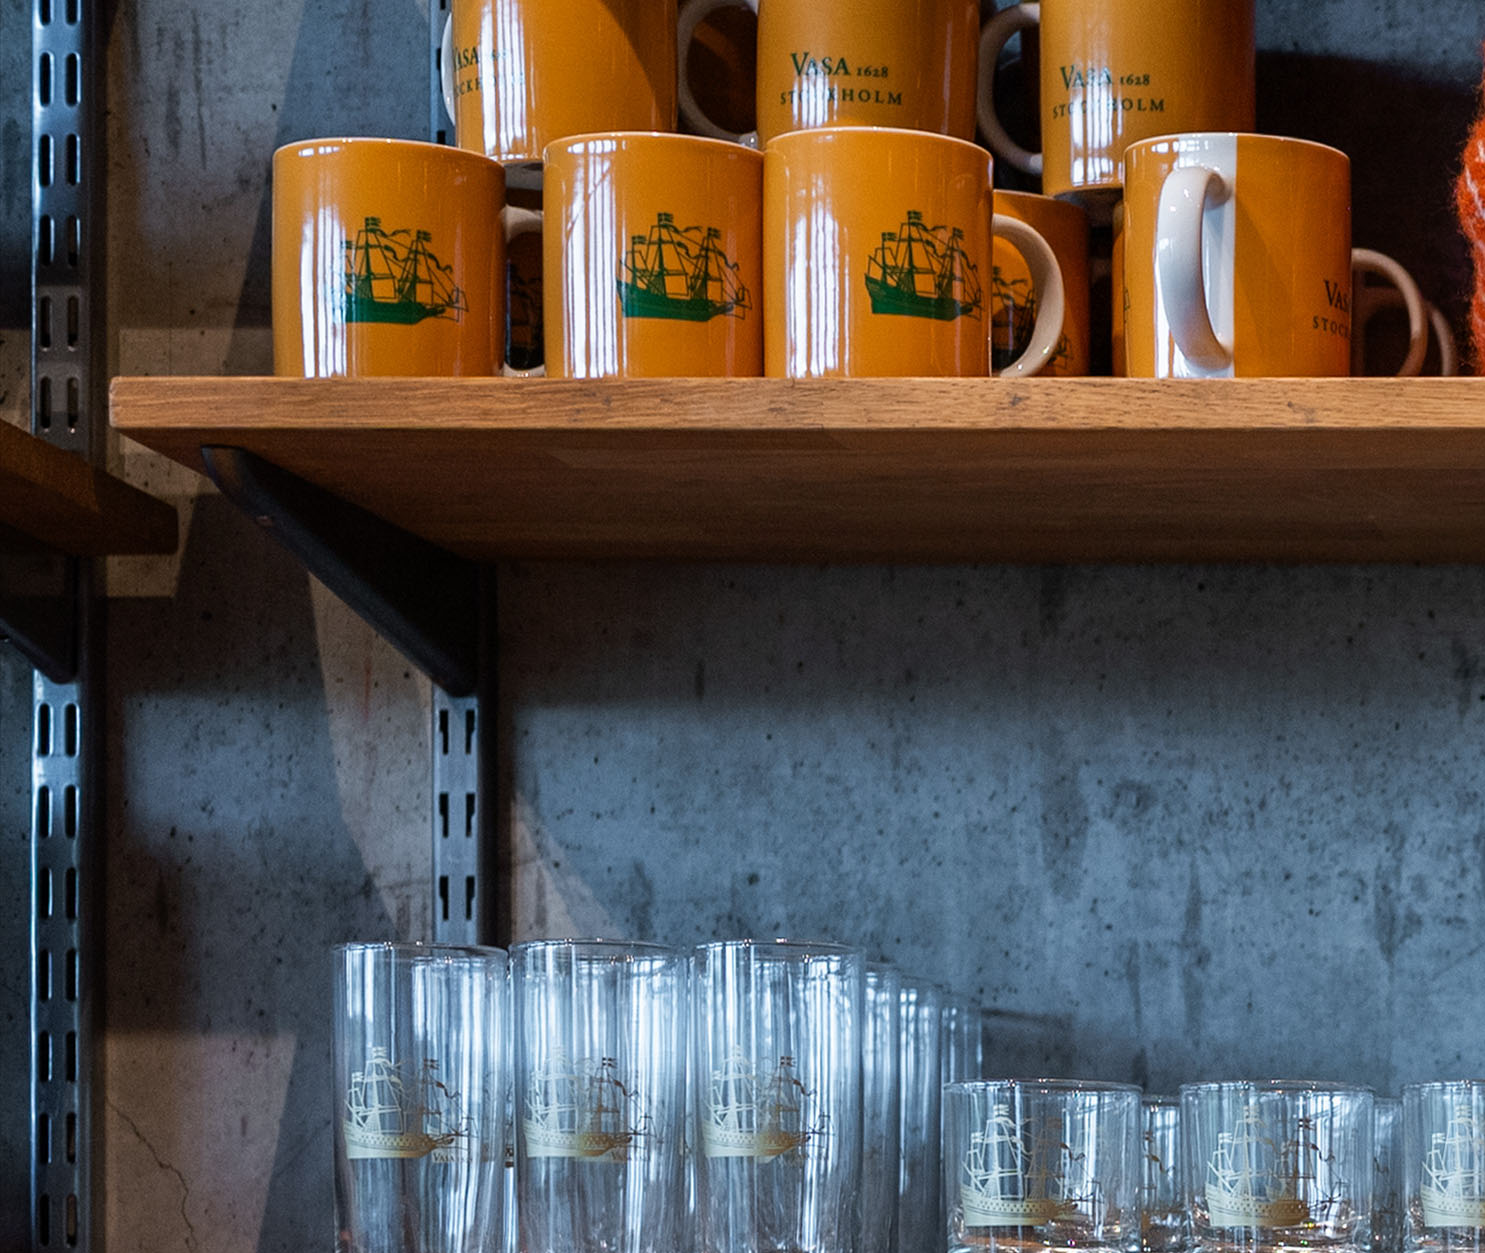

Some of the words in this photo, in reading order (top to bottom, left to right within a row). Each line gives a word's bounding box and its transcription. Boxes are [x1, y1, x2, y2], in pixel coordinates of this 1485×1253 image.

[791, 52, 851, 76] VASA
[857, 66, 889, 78] 1628
[1060, 65, 1112, 91] VASA
[1119, 74, 1150, 86] 1628
